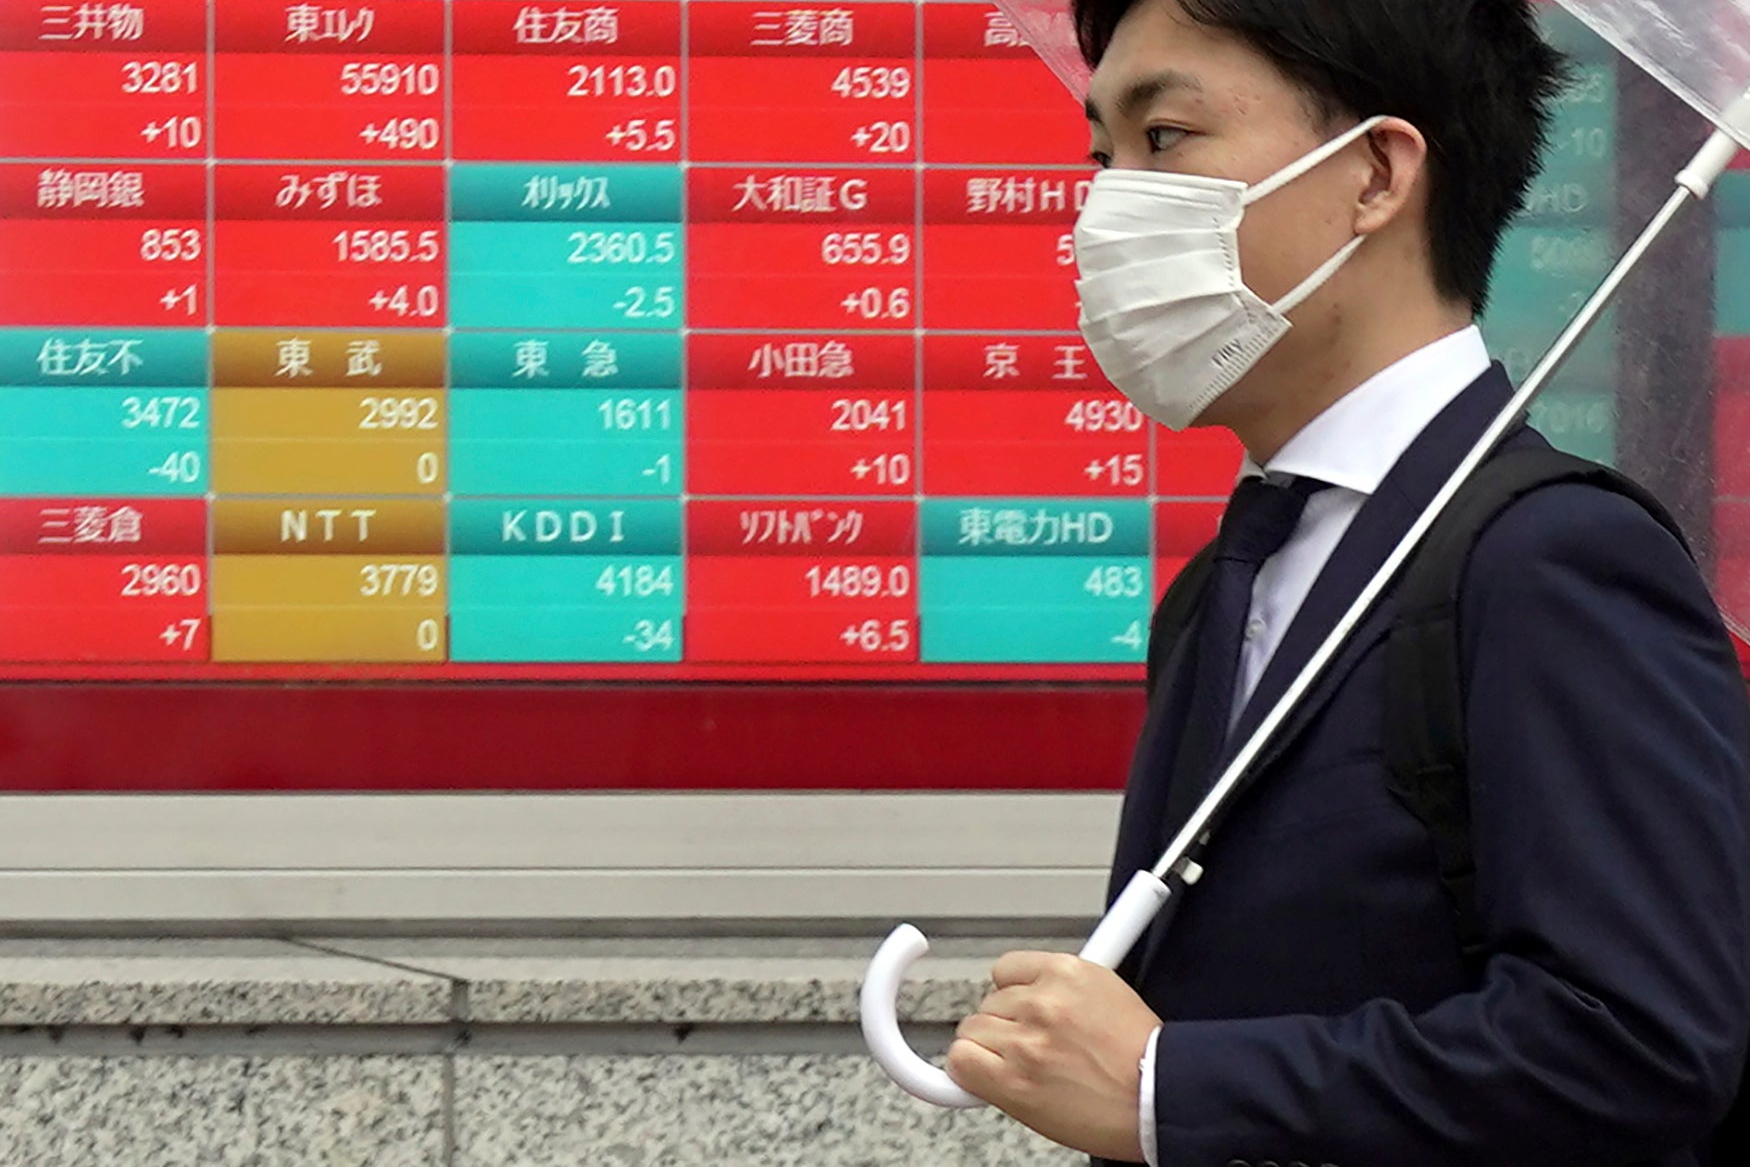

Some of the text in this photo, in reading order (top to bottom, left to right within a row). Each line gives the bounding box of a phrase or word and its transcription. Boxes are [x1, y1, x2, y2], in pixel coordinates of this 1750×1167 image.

[38, 2, 145, 41] 三井物
[512, 5, 619, 45] 住友商
[750, 7, 855, 47] 三菱商
[121, 60, 198, 94] 3281
[566, 63, 677, 98] 2113.0
[275, 170, 383, 210] みずほ
[732, 174, 868, 214] 大和証G
[332, 229, 440, 263] 1585.5
[821, 231, 911, 266] 655.9
[35, 337, 143, 377] 住友不
[747, 339, 855, 380] 小田急
[121, 395, 202, 430] 3472
[597, 397, 672, 431] 1611
[39, 504, 144, 544] 三菱倉
[958, 506, 1113, 548] 東電力HD
[359, 562, 440, 598] 3779
[804, 564, 911, 599] 1489.0
